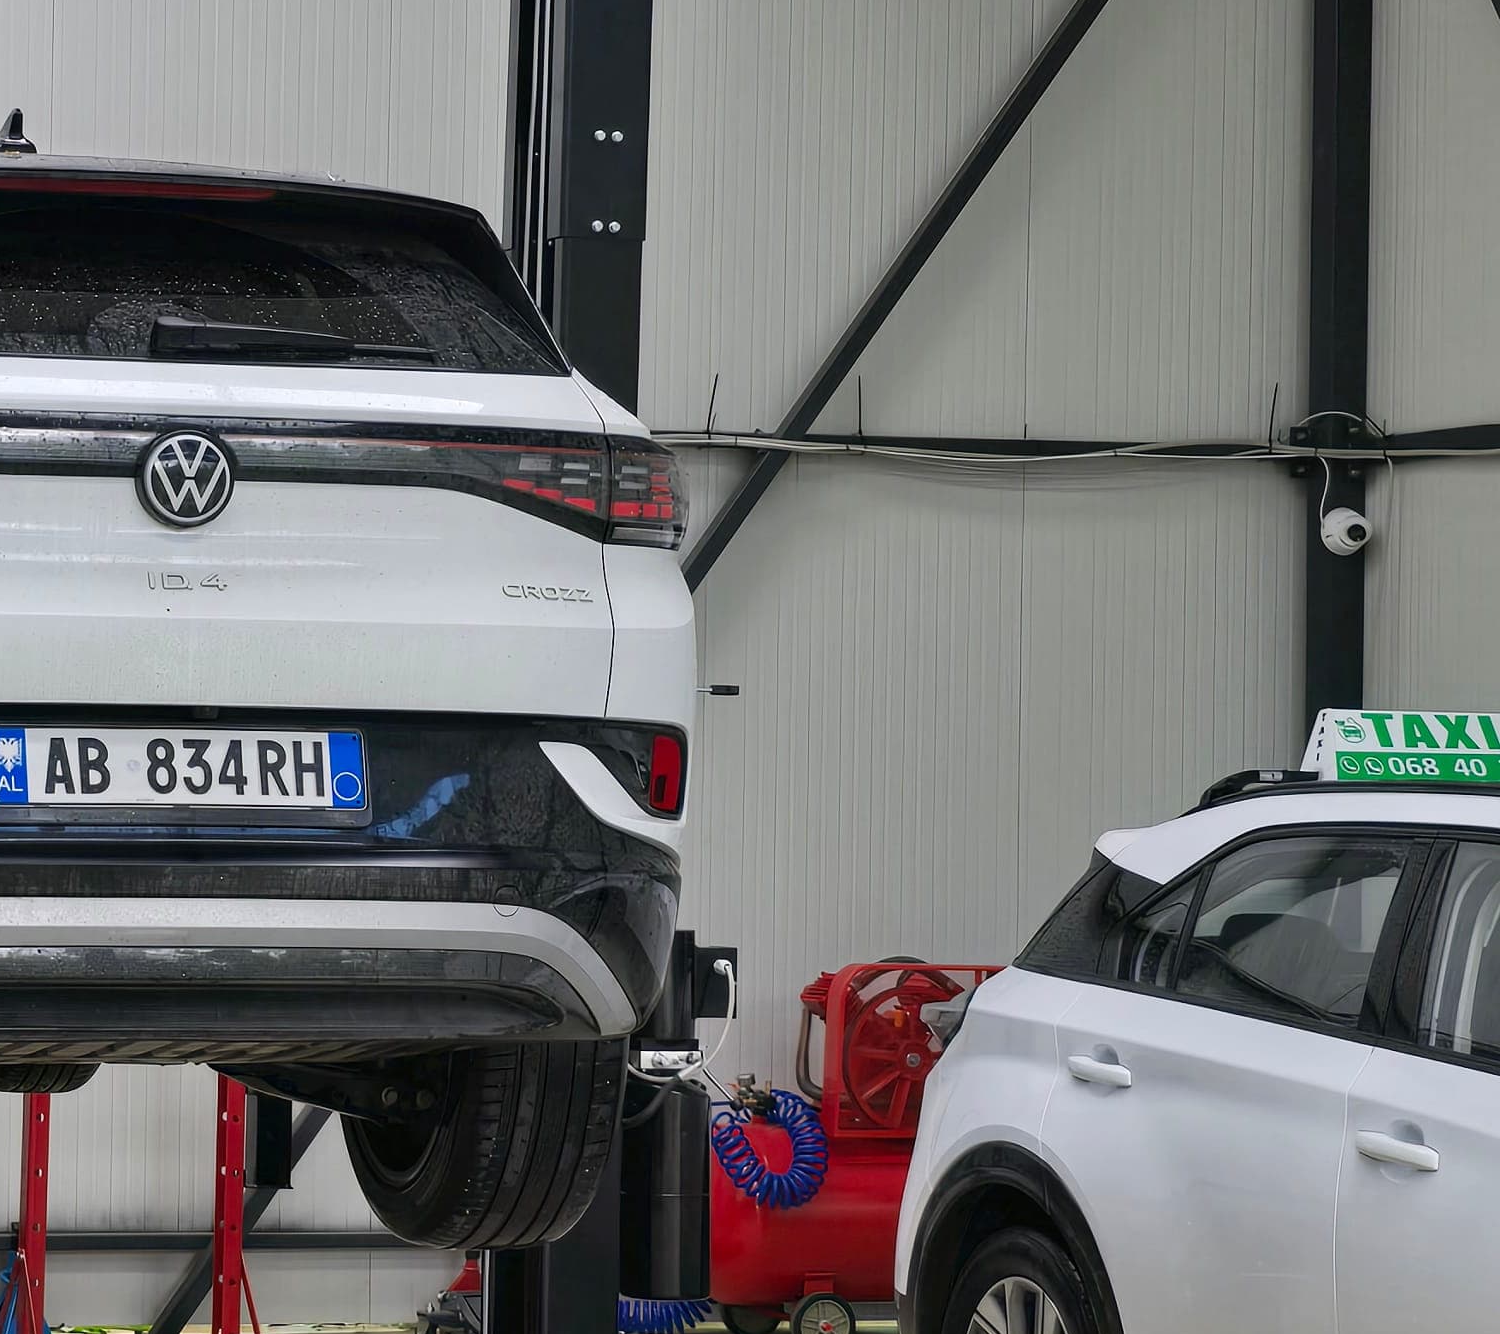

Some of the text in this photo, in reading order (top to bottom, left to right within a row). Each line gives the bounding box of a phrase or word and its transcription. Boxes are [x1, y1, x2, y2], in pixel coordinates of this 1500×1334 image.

[502, 585, 593, 602] CROZZ
[1361, 713, 1500, 750] TAXI
[45, 737, 111, 795] AB
[1388, 757, 1487, 776] 068 40
